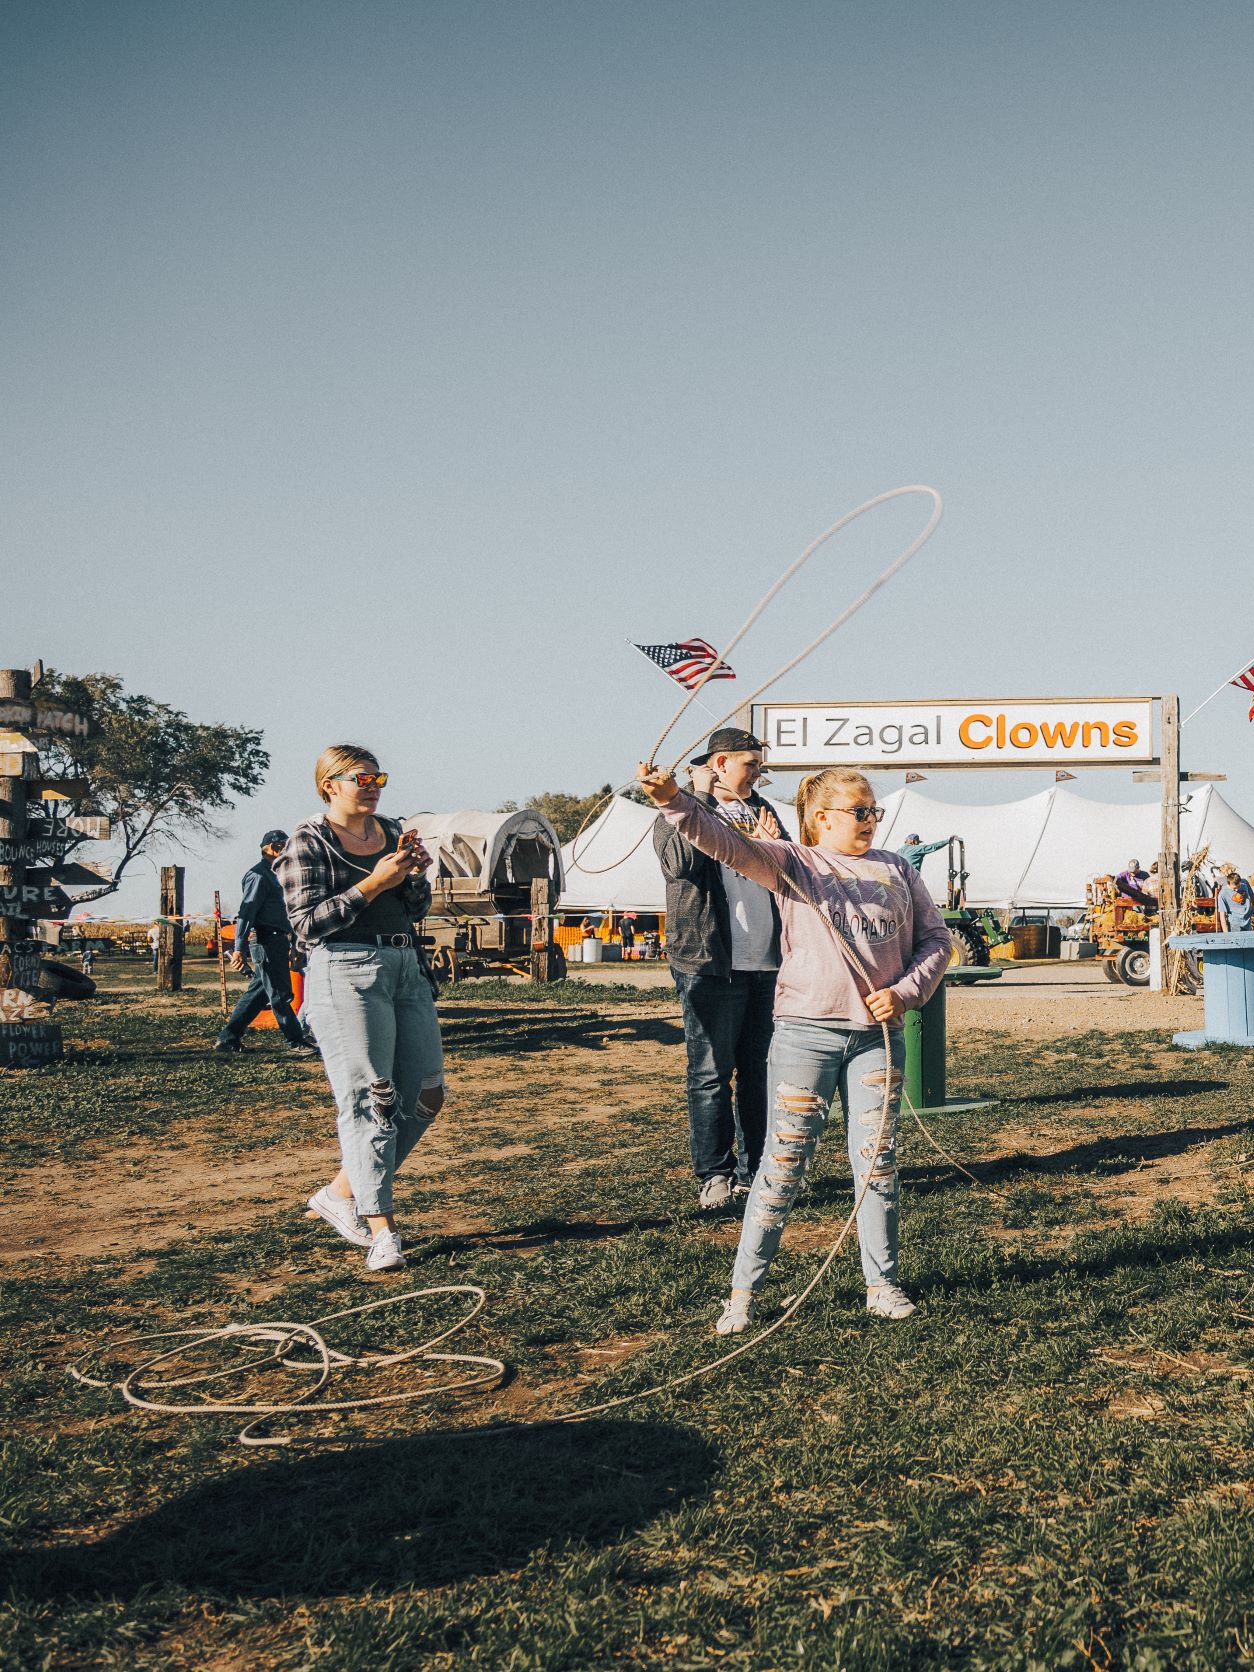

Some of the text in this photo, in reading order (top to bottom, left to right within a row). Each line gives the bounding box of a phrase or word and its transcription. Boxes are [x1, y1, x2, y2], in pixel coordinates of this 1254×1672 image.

[775, 714, 1139, 753] El Zagal Clowns
[42, 817, 101, 839] MORE
[0, 839, 65, 862] BOUNCE HOUSES
[828, 909, 897, 939] OLORADO
[2, 1024, 47, 1039] FLOWER
[9, 1040, 60, 1058] POWER
